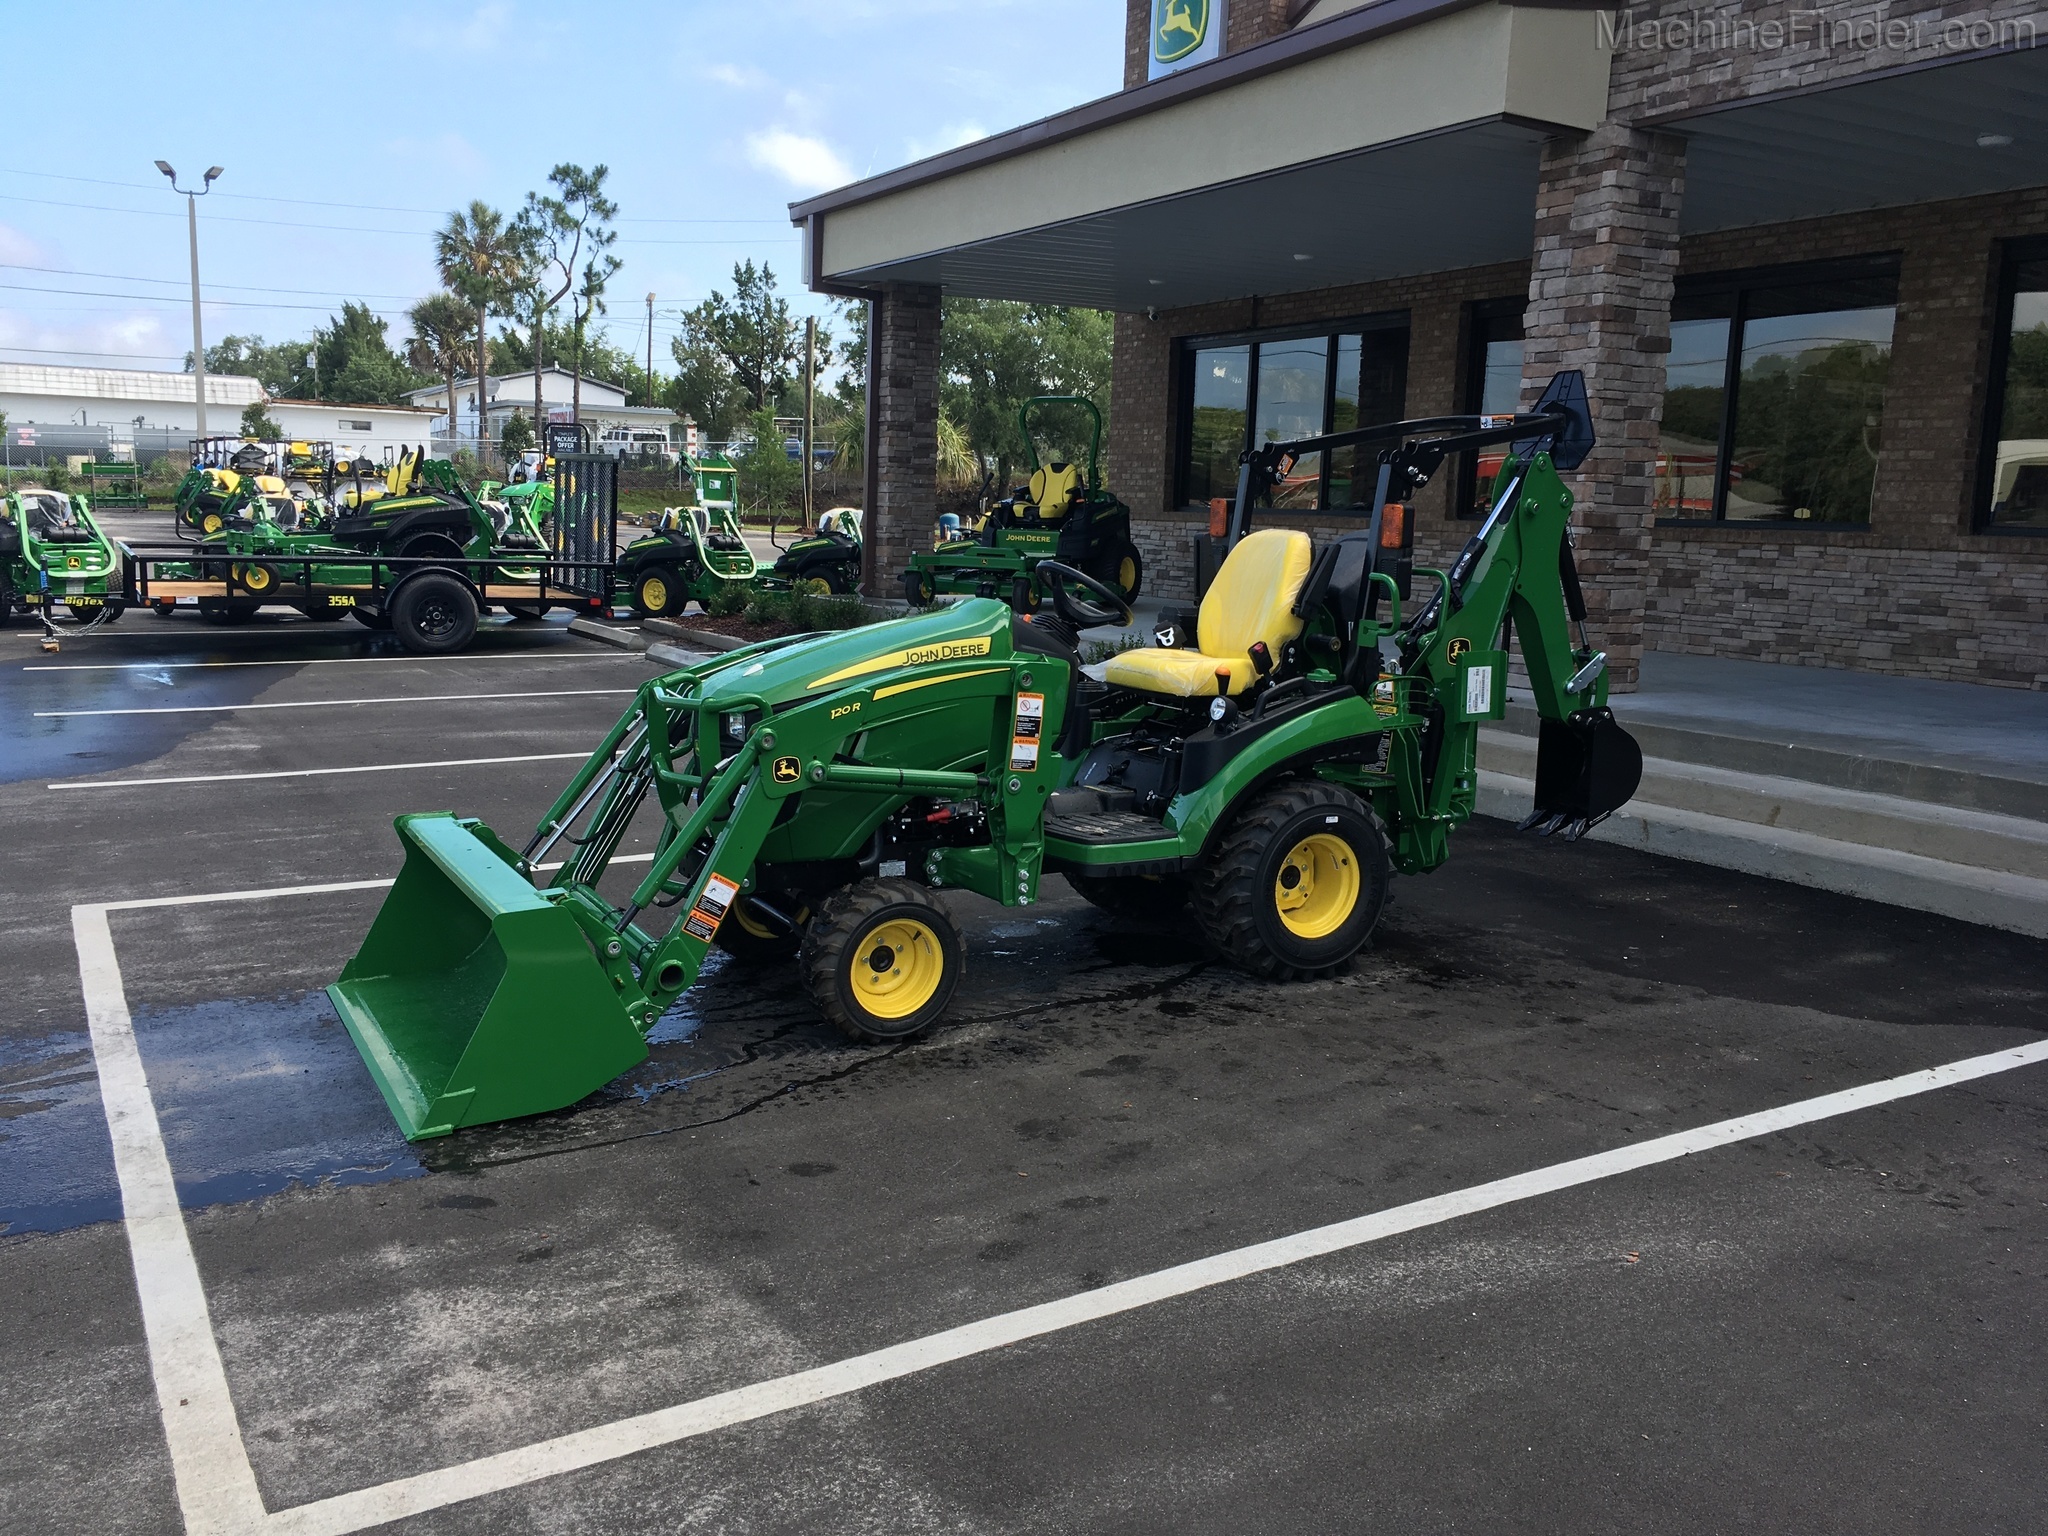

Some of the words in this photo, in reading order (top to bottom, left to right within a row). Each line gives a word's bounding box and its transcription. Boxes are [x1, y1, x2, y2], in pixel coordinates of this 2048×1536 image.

[1006, 534, 1026, 542] JOHN
[1026, 534, 1051, 543] DEERE
[902, 649, 939, 665] JOHN
[942, 643, 985, 658] DEERE
[830, 705, 851, 720] 120
[852, 702, 861, 712] R
